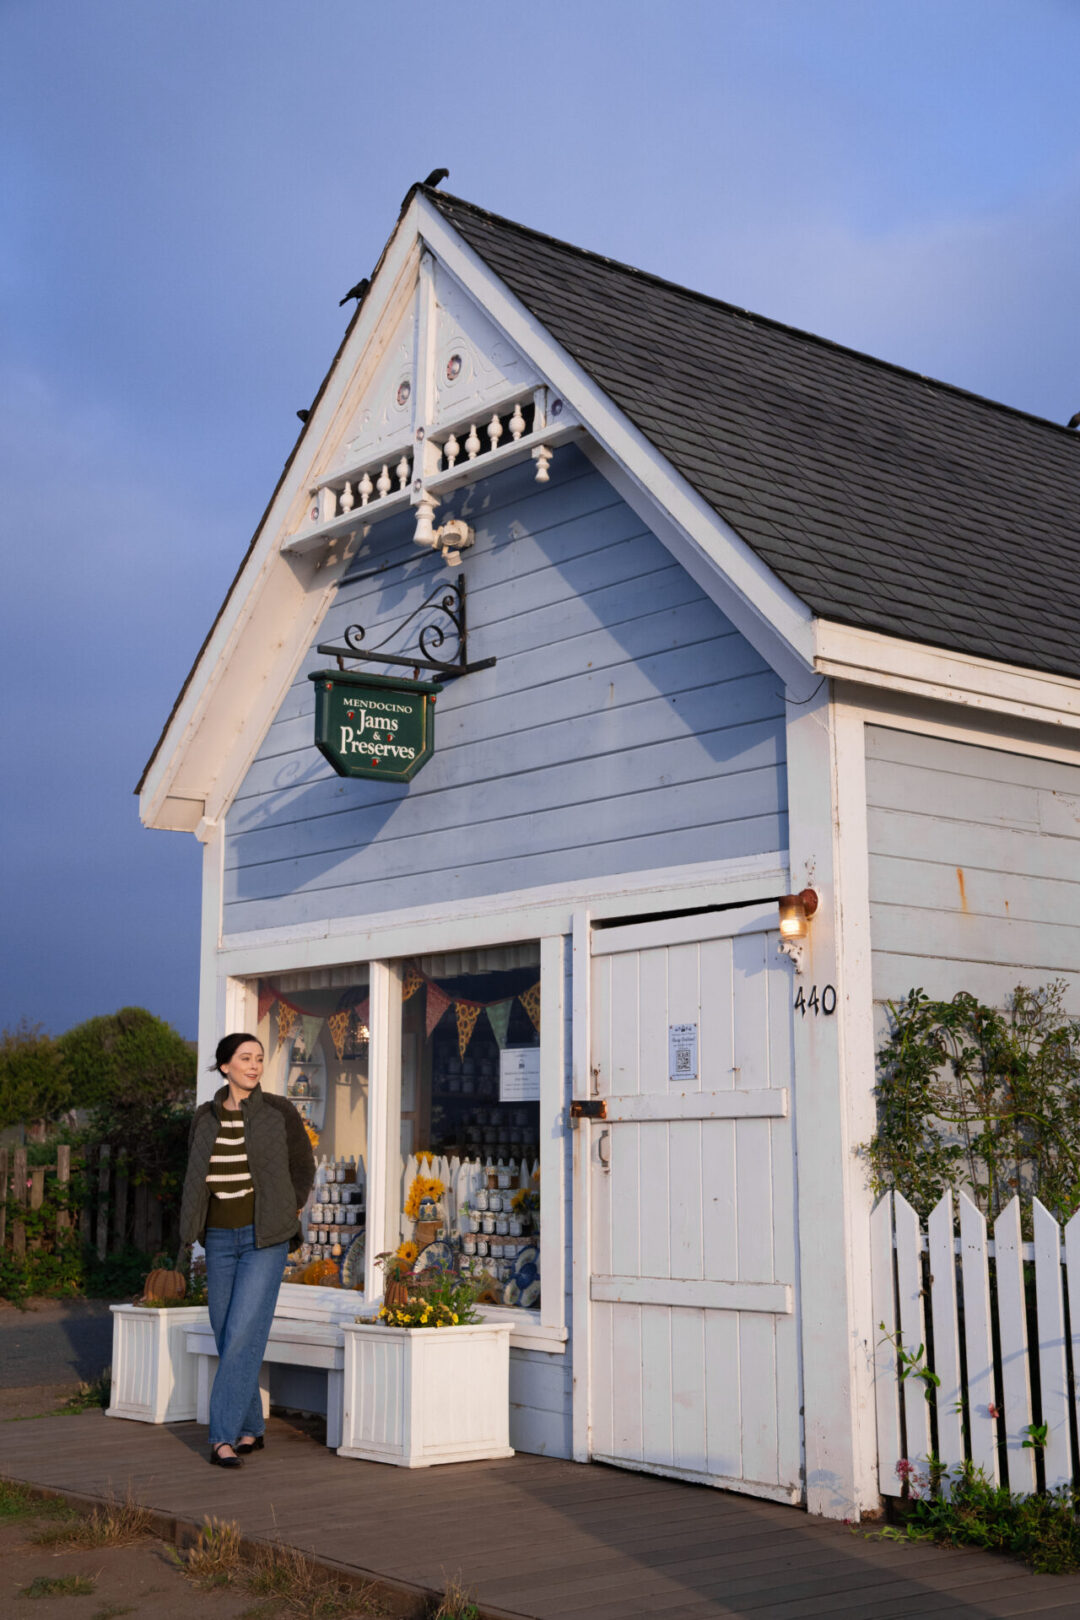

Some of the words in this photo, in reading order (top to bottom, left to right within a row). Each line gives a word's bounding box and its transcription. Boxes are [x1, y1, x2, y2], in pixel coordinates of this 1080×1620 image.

[343, 698, 413, 714] MENDOCINO
[356, 709, 399, 735] Jams
[340, 726, 415, 760] Preserves
[372, 731, 382, 741] &
[794, 984, 837, 1018] 440
